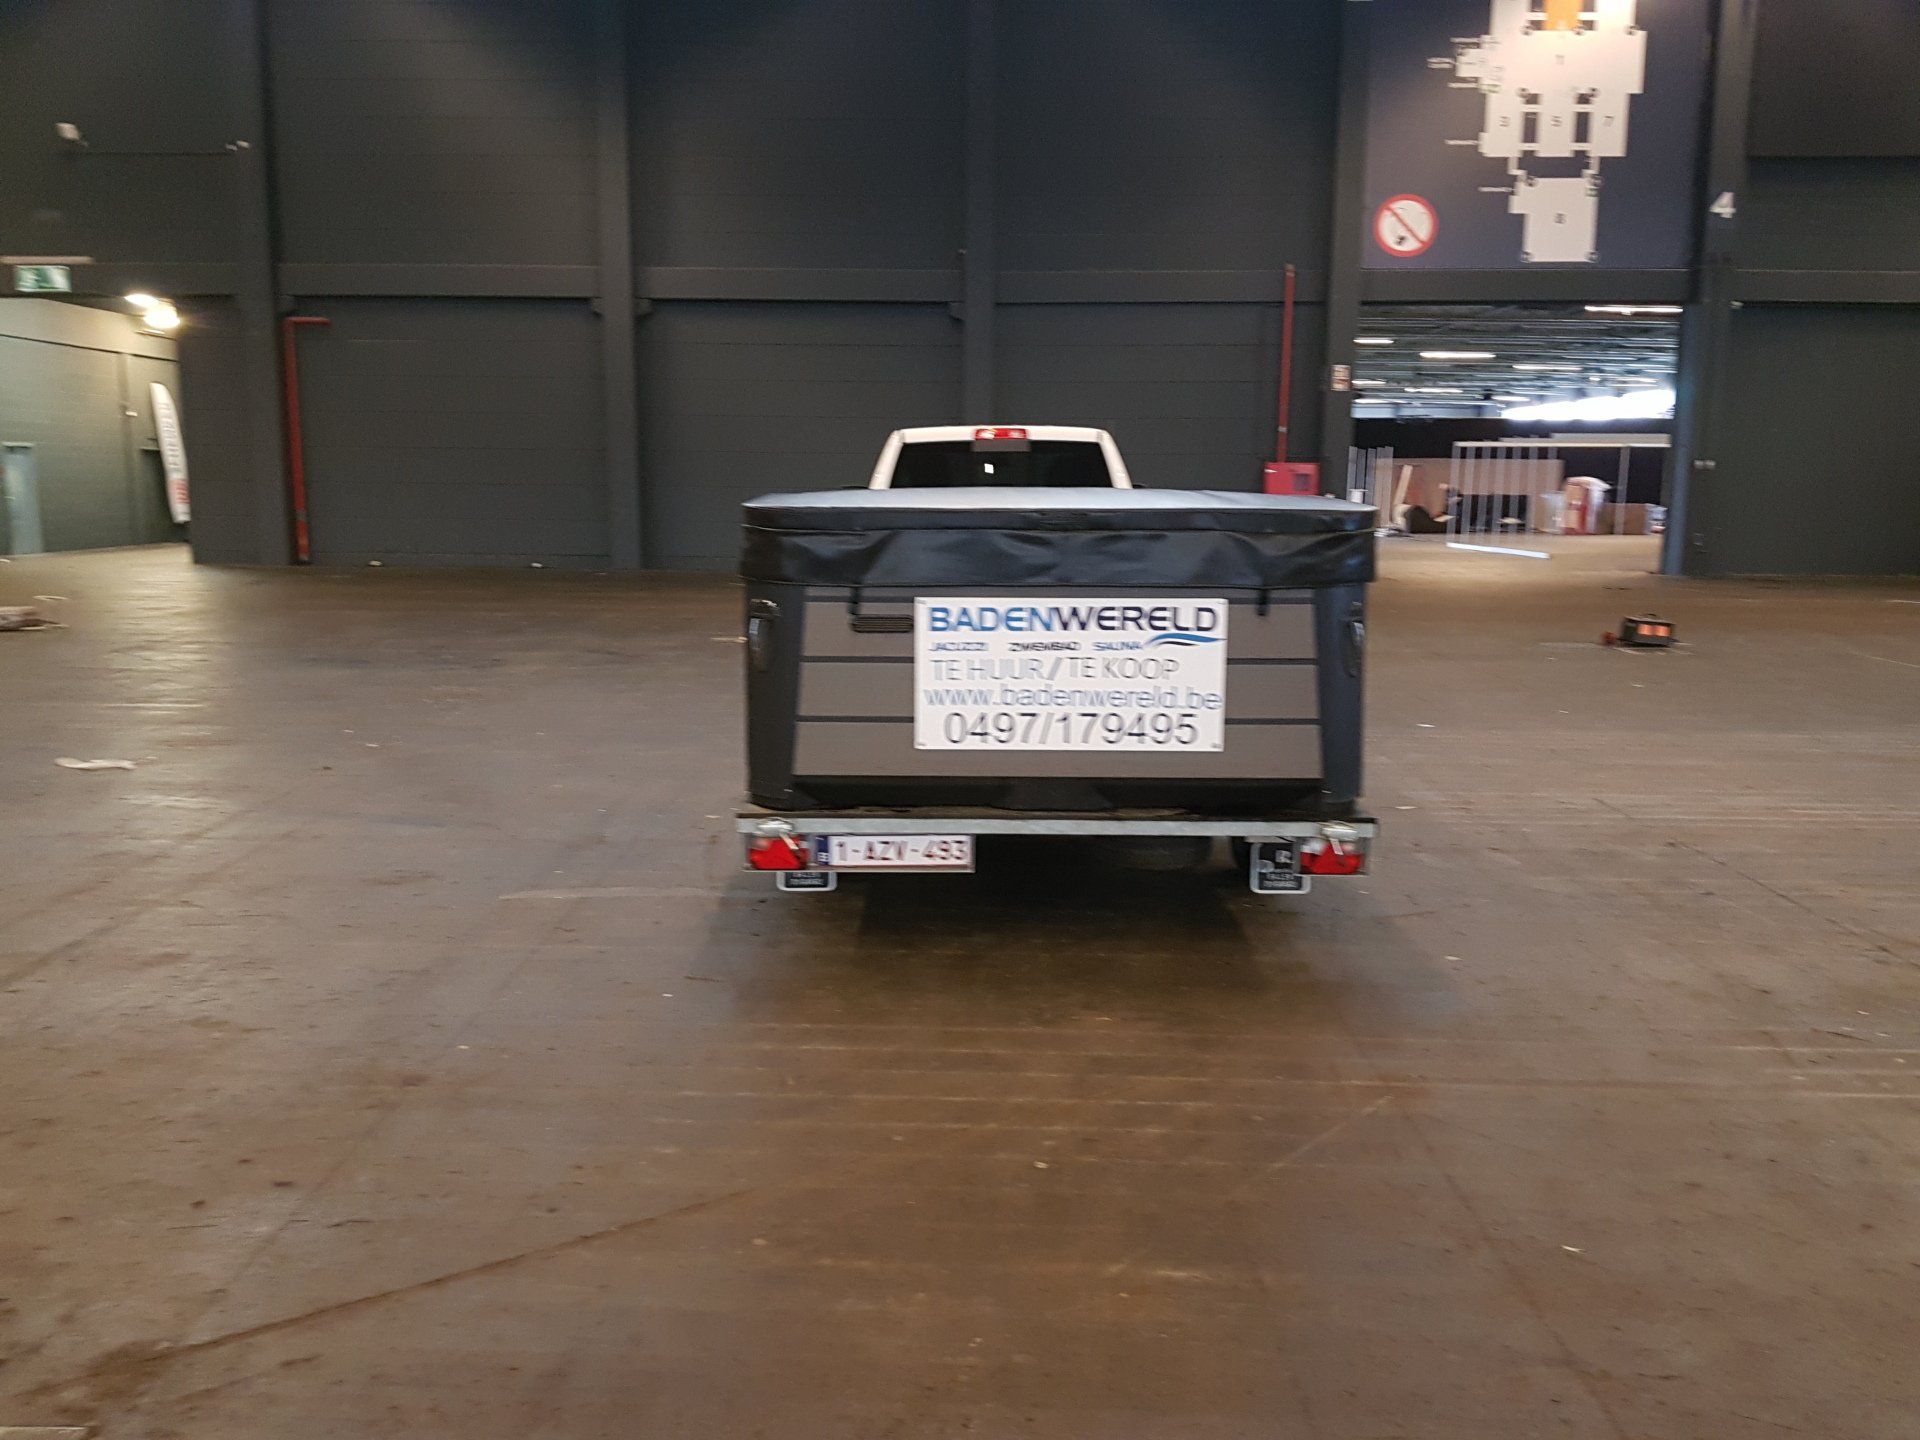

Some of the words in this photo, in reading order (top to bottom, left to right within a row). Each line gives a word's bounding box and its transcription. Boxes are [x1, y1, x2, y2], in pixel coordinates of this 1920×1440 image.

[1709, 191, 1736, 218] 4
[927, 607, 1217, 632] BADENWERELD
[930, 659, 961, 680] TE
[1102, 657, 1180, 680] KOOP
[923, 685, 1223, 710] www.badenwereld.be
[943, 712, 1198, 744] 0497/179495
